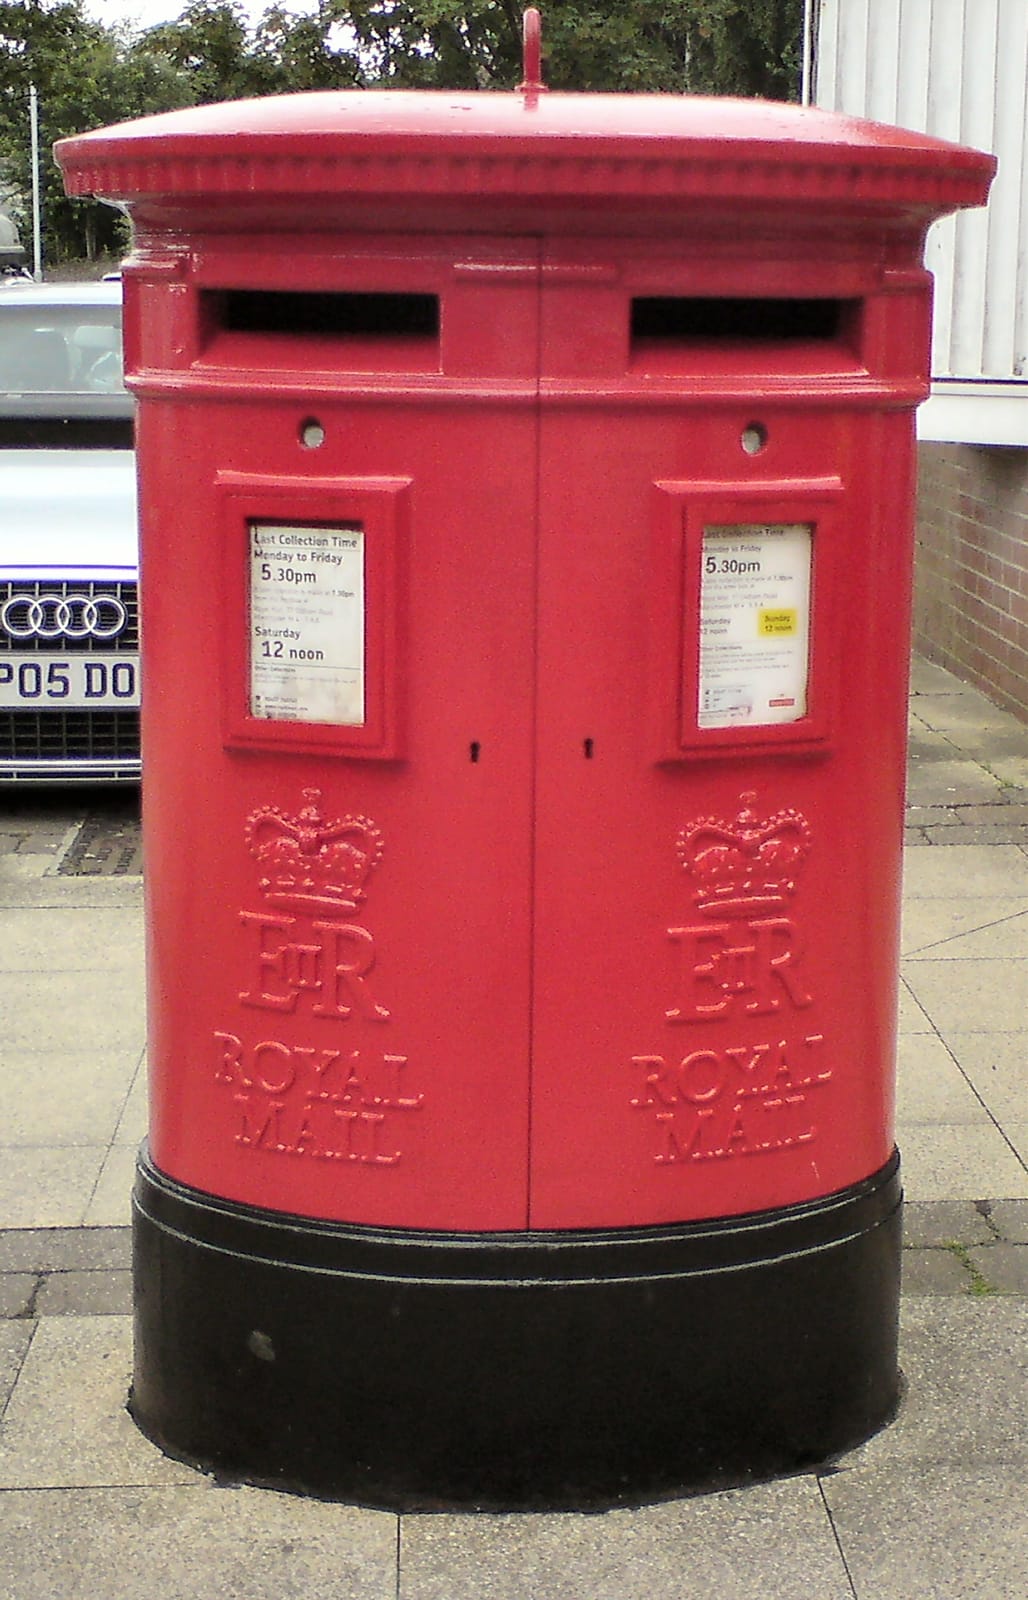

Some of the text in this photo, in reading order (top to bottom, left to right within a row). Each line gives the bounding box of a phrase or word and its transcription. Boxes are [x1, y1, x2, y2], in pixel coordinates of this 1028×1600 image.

[279, 534, 329, 547] Collection
[331, 536, 358, 548] Time
[254, 549, 343, 566] Monday to Friday
[705, 556, 761, 575] 5.30pm
[261, 563, 317, 585] 5.30pm
[255, 626, 301, 640] Saturday
[262, 640, 324, 660] 12 noon
[213, 1031, 425, 1110] ROYAL
[630, 1034, 833, 1106] ROYAL
[234, 1094, 402, 1165] MAIL
[653, 1095, 816, 1166] MAIL
